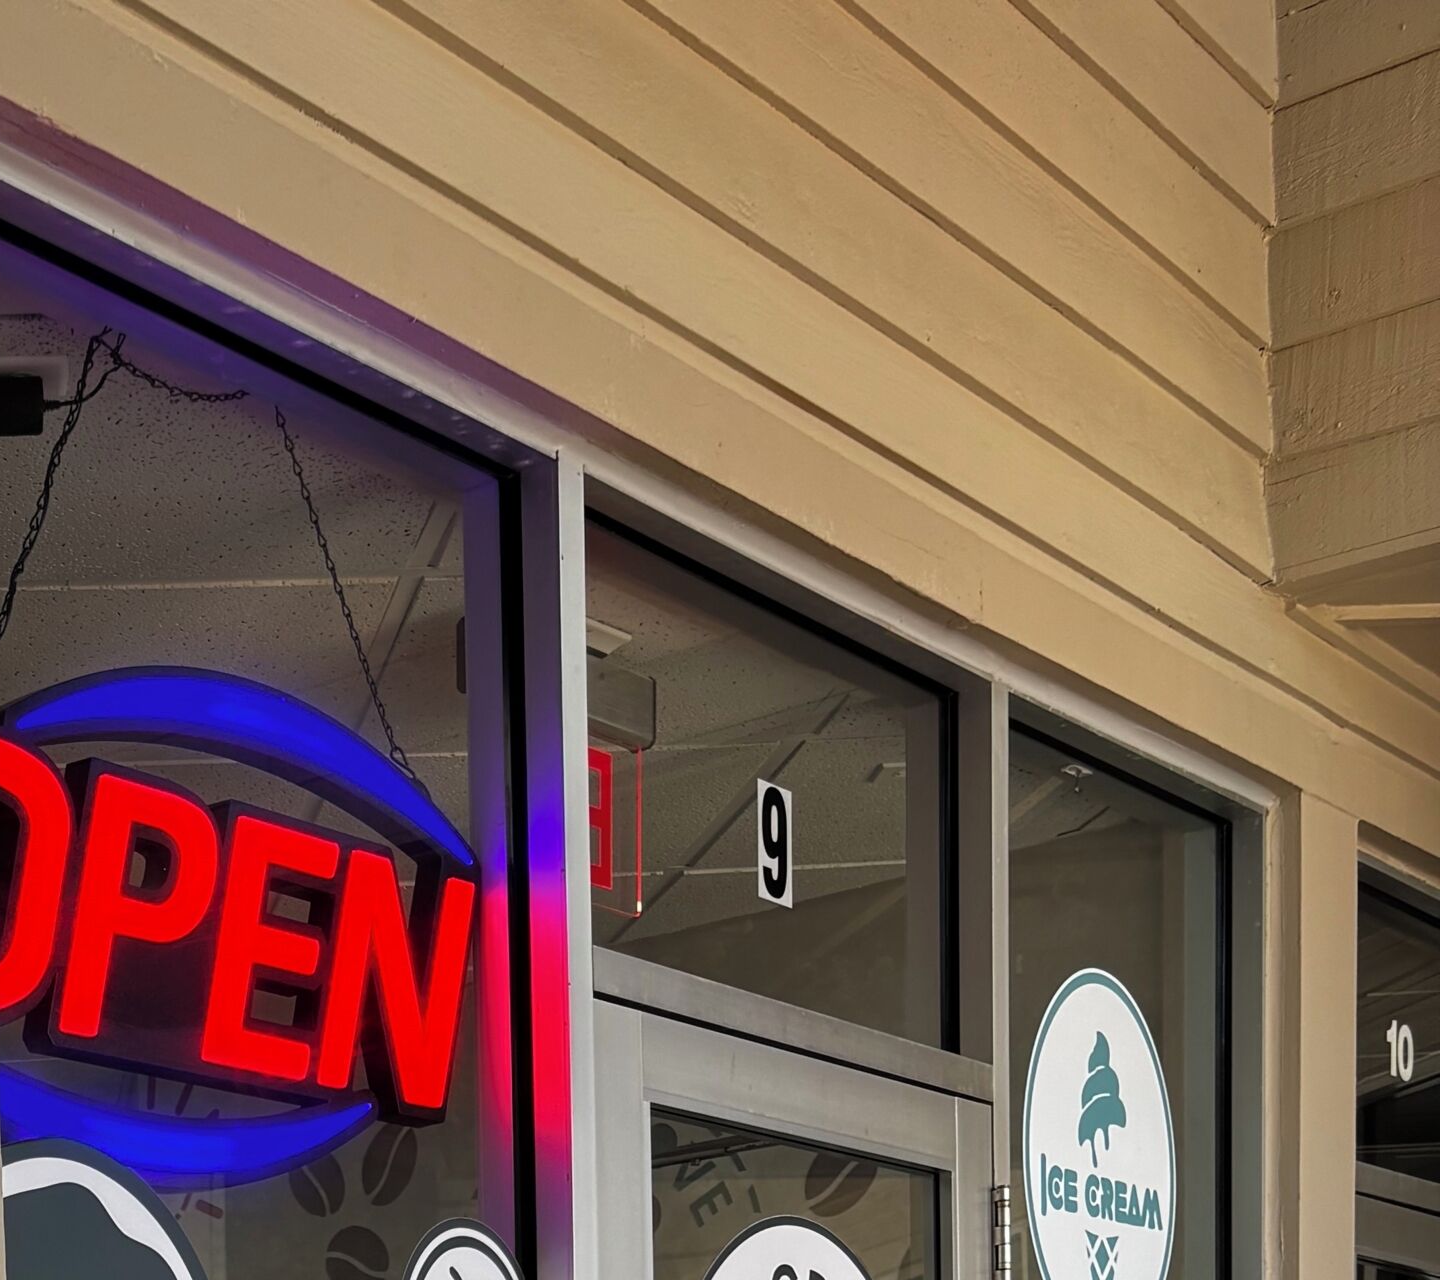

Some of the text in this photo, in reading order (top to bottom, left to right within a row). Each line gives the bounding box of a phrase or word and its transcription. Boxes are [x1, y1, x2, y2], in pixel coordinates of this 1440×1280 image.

[760, 785, 790, 899] 9
[1385, 1019, 1415, 1082] 10
[1040, 1152, 1164, 1231] ICE CREAM
